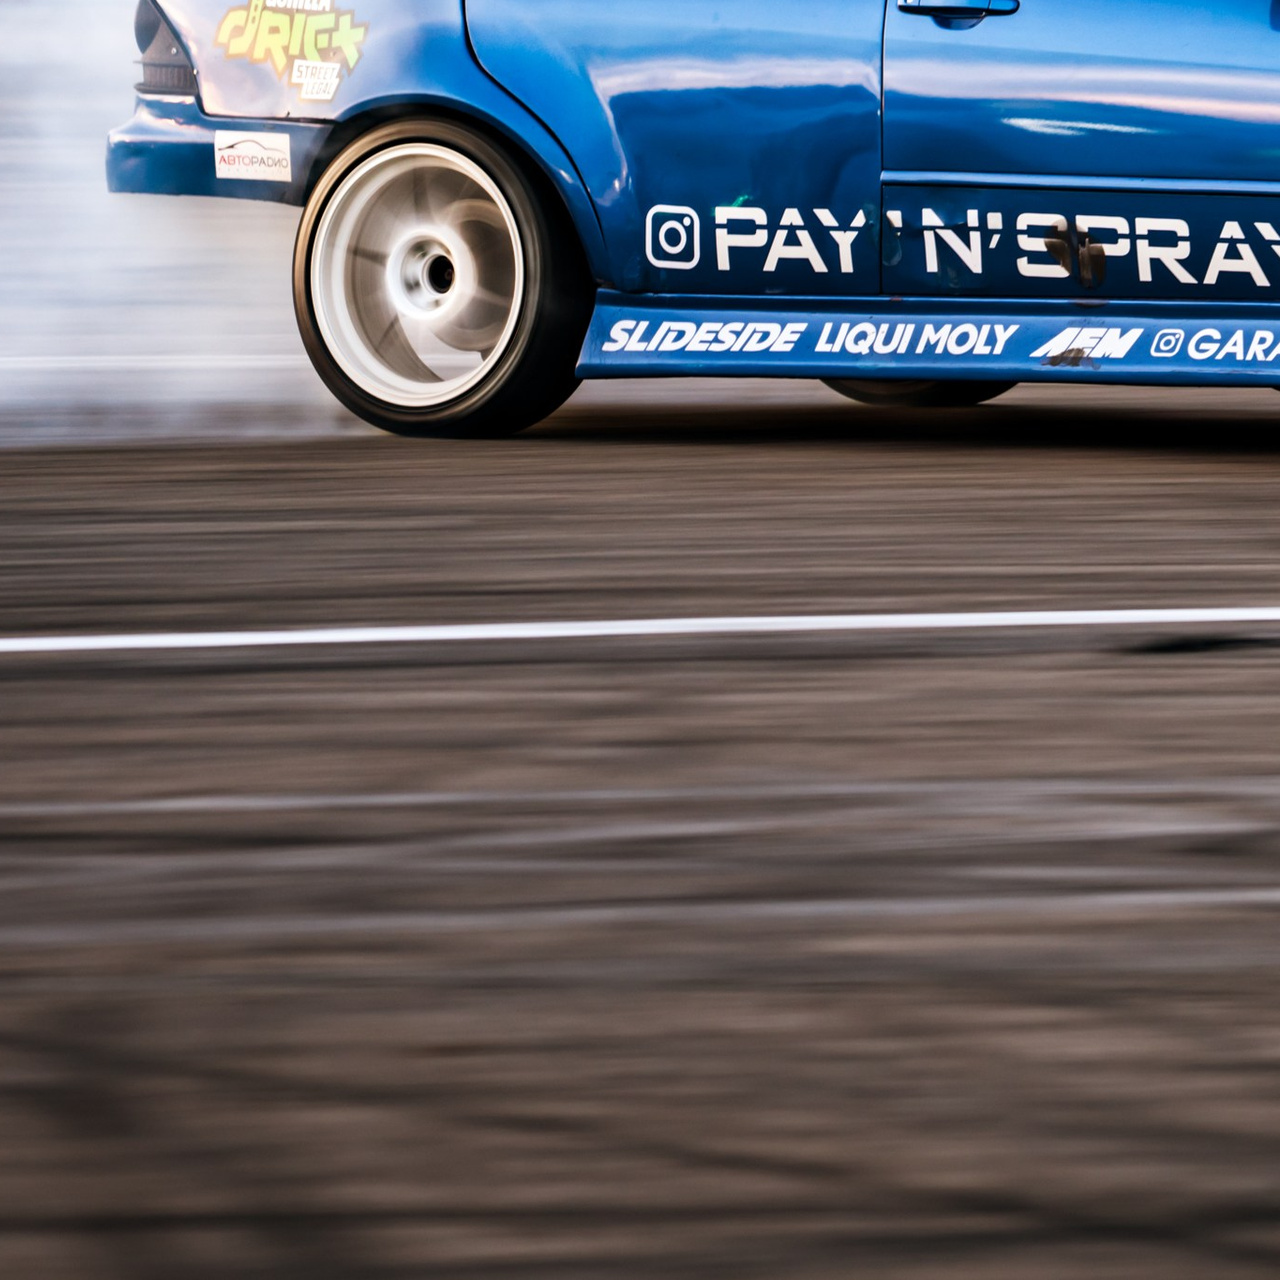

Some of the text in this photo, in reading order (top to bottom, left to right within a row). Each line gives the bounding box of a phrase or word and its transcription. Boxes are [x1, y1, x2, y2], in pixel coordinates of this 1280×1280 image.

[715, 206, 866, 273] PAY
[601, 320, 808, 352] SLIDESIDE
[815, 321, 1020, 355] LIQUI MOLY
